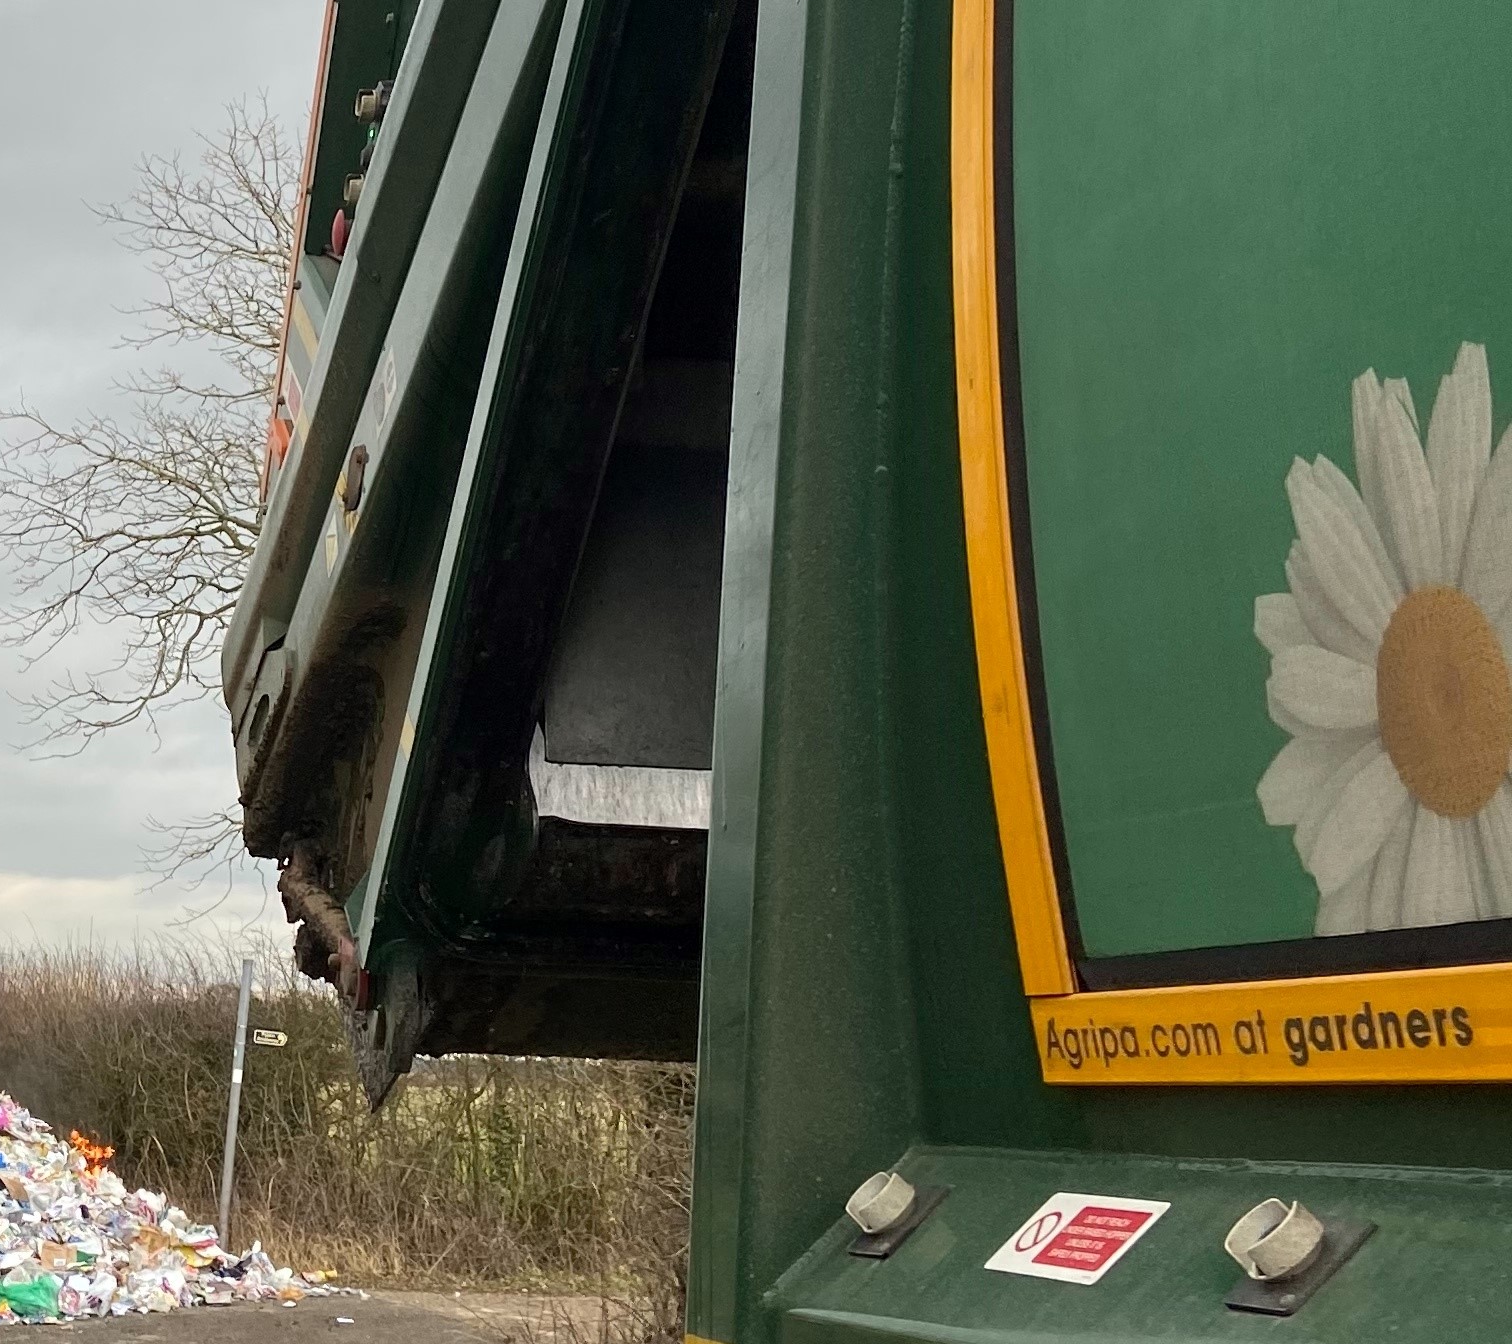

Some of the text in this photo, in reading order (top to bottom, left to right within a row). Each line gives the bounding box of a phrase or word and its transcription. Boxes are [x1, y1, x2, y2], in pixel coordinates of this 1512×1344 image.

[1046, 1001, 1474, 1070] Agripa.com at gardners
